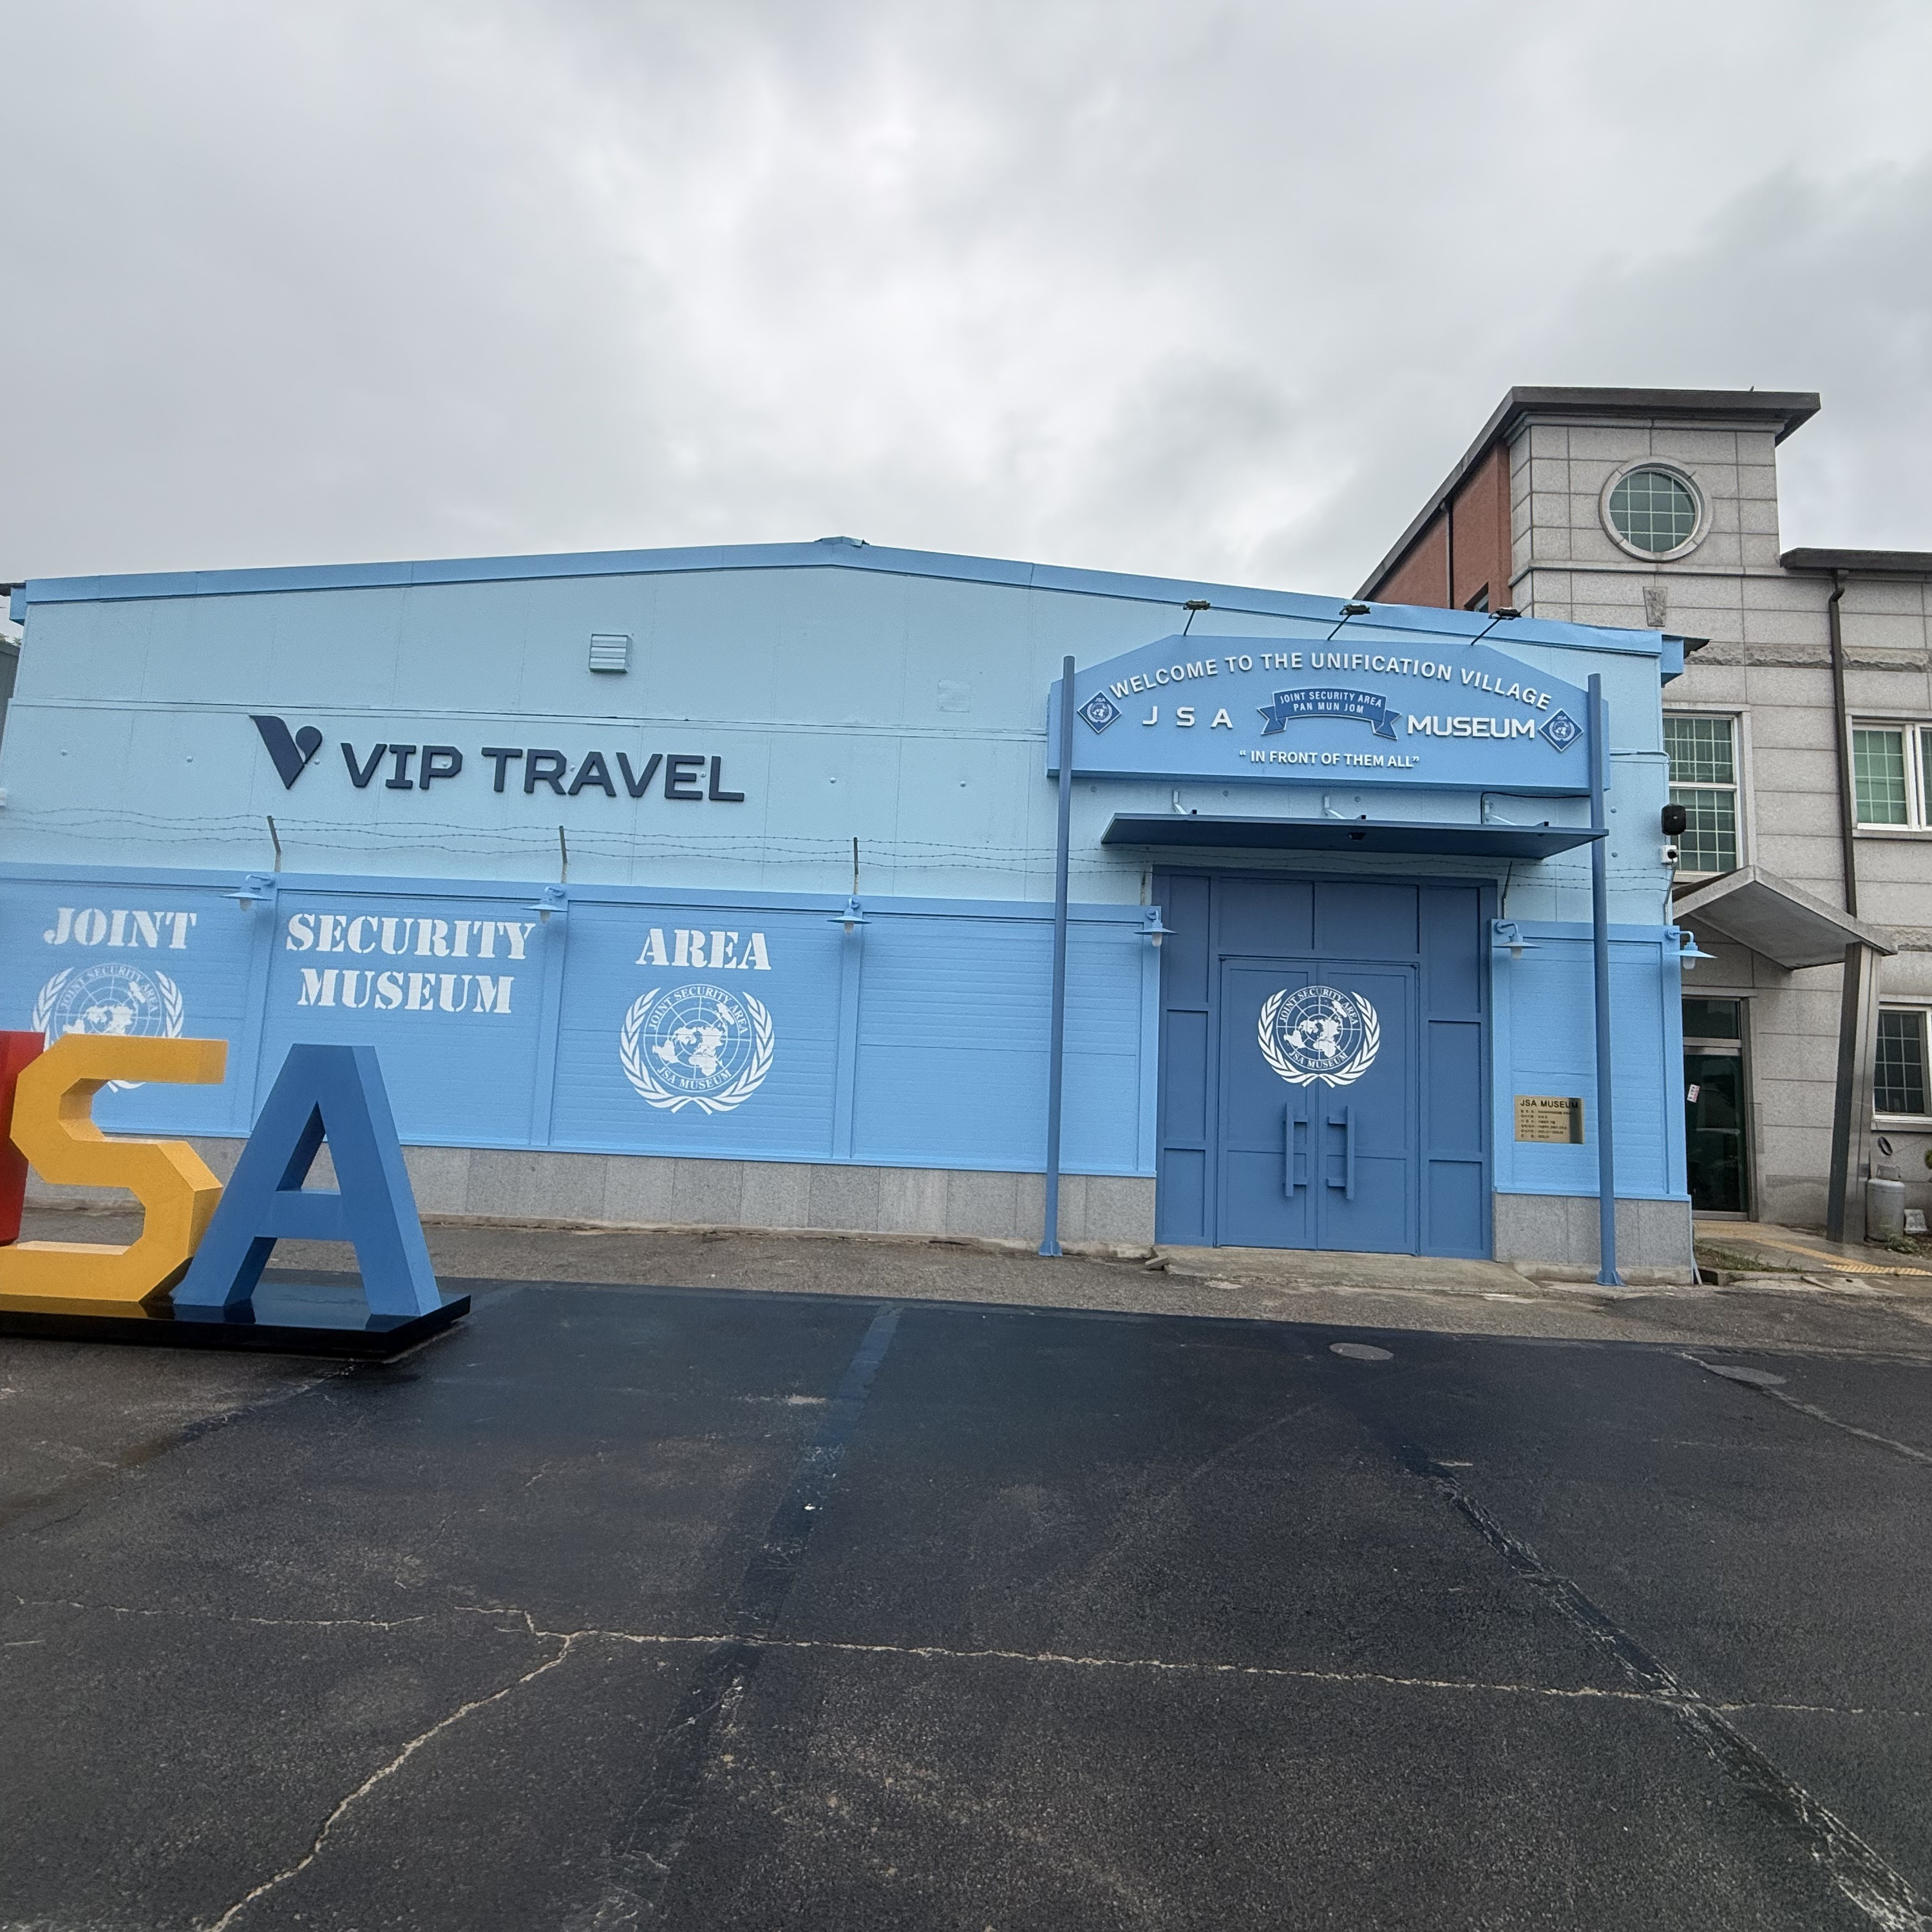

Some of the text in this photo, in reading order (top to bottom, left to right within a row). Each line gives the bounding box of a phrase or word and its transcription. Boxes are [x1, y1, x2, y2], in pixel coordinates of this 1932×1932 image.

[1110, 652, 1553, 711] WELCOME TO THE UNIFICATION VILLAGE
[1280, 690, 1382, 708] JOINT SECURITY AREA
[1293, 702, 1364, 714] PAN MUN JOM
[1407, 714, 1536, 739] MUSEUM
[340, 743, 745, 802] VIP TRAVEL
[1269, 751, 1318, 764] FRONT
[1321, 752, 1341, 765] OF
[1343, 753, 1385, 767] THEM
[43, 907, 197, 949] JOINT
[285, 913, 536, 960] SECURITY
[635, 928, 772, 971] AREA
[60, 965, 159, 1012] JOINT SECURITY AREA
[297, 968, 515, 1014] MUSEUM
[1278, 988, 1359, 1026] JOINT SECURITY AREA
[648, 986, 749, 1034] JOINT SECURITY AREA
[656, 1066, 732, 1090] JSA MUSEUM
[1288, 1050, 1349, 1069] JSA MUSEUM
[1520, 1099, 1578, 1108] JSA MUSEUM
